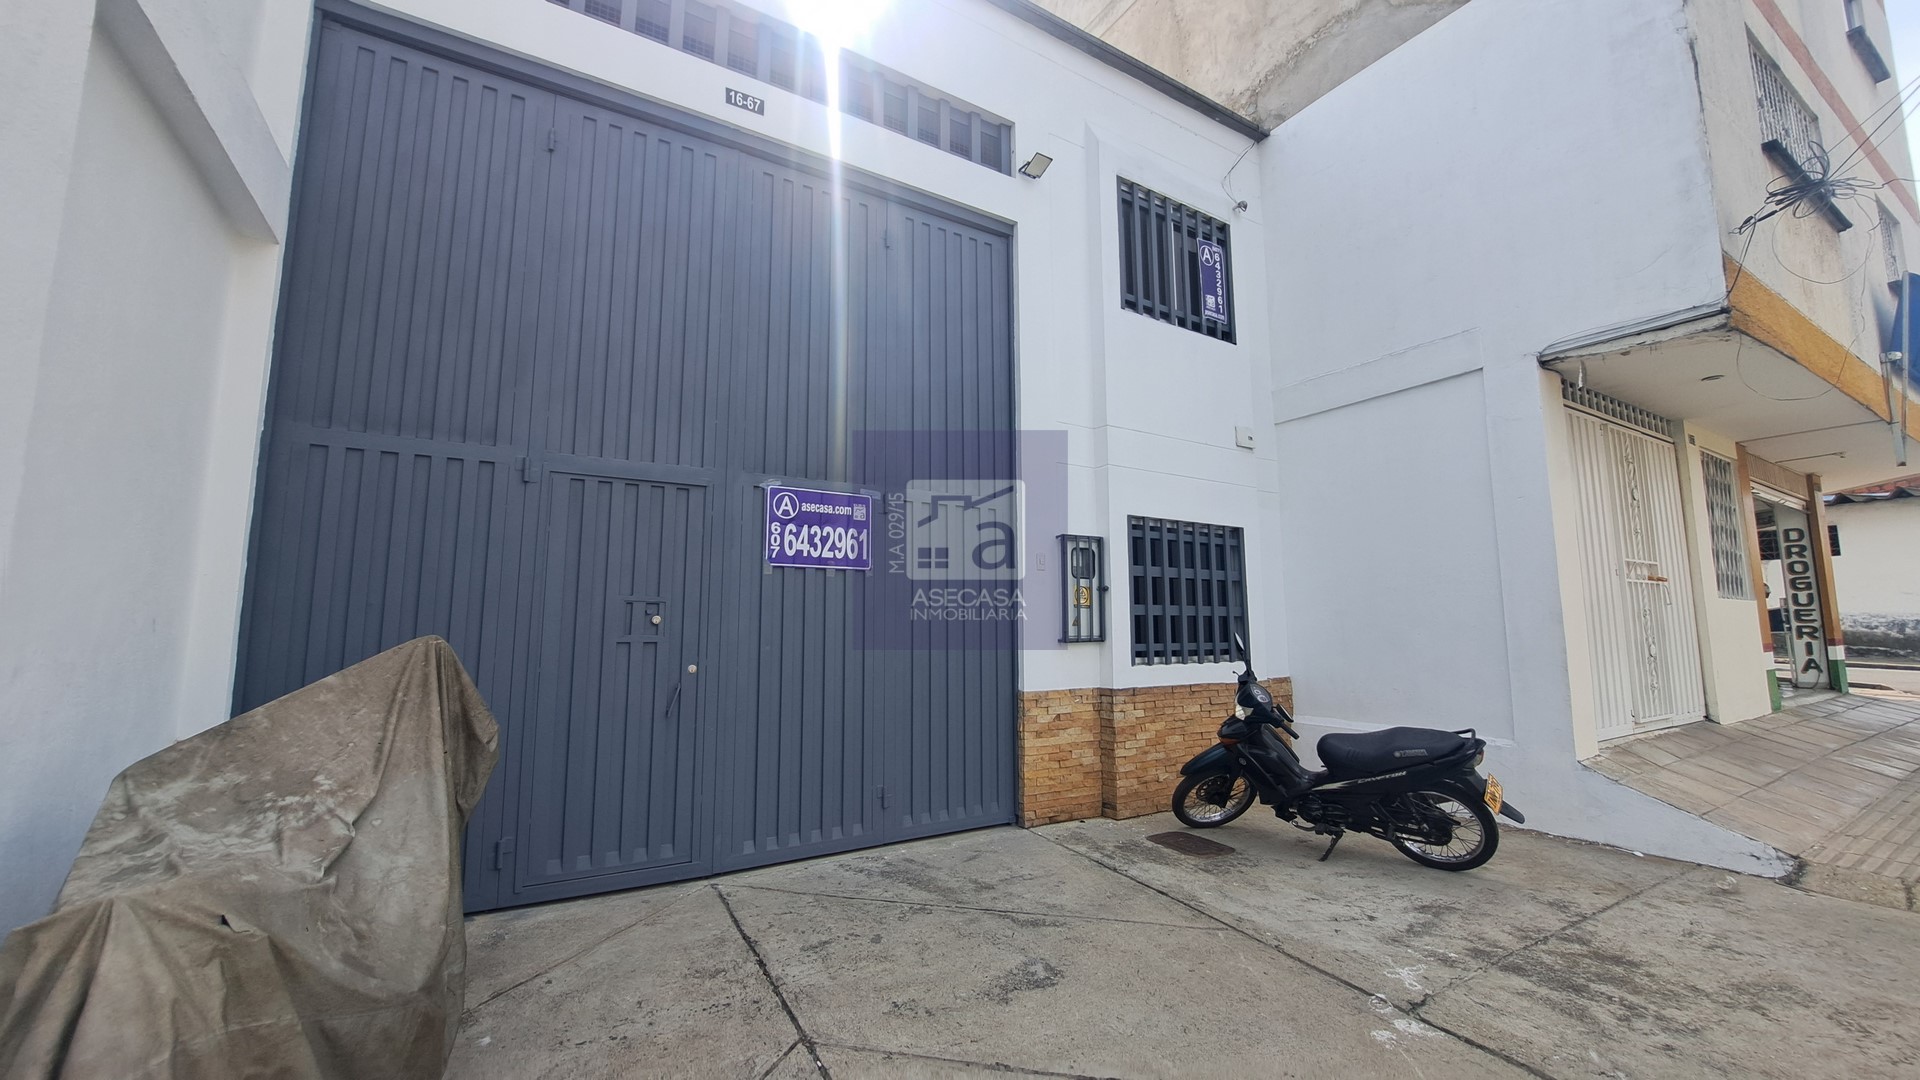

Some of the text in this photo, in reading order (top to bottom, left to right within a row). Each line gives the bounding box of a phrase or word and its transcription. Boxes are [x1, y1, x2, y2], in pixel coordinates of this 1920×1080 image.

[729, 91, 760, 111] 16-67
[1202, 247, 1212, 263] A
[1214, 253, 1223, 313] 6432961
[777, 496, 795, 516] A
[801, 502, 852, 515] asecasa.com
[770, 522, 781, 558] 607
[784, 523, 868, 560] 6432961
[1783, 528, 1823, 673] DROGUERIA
